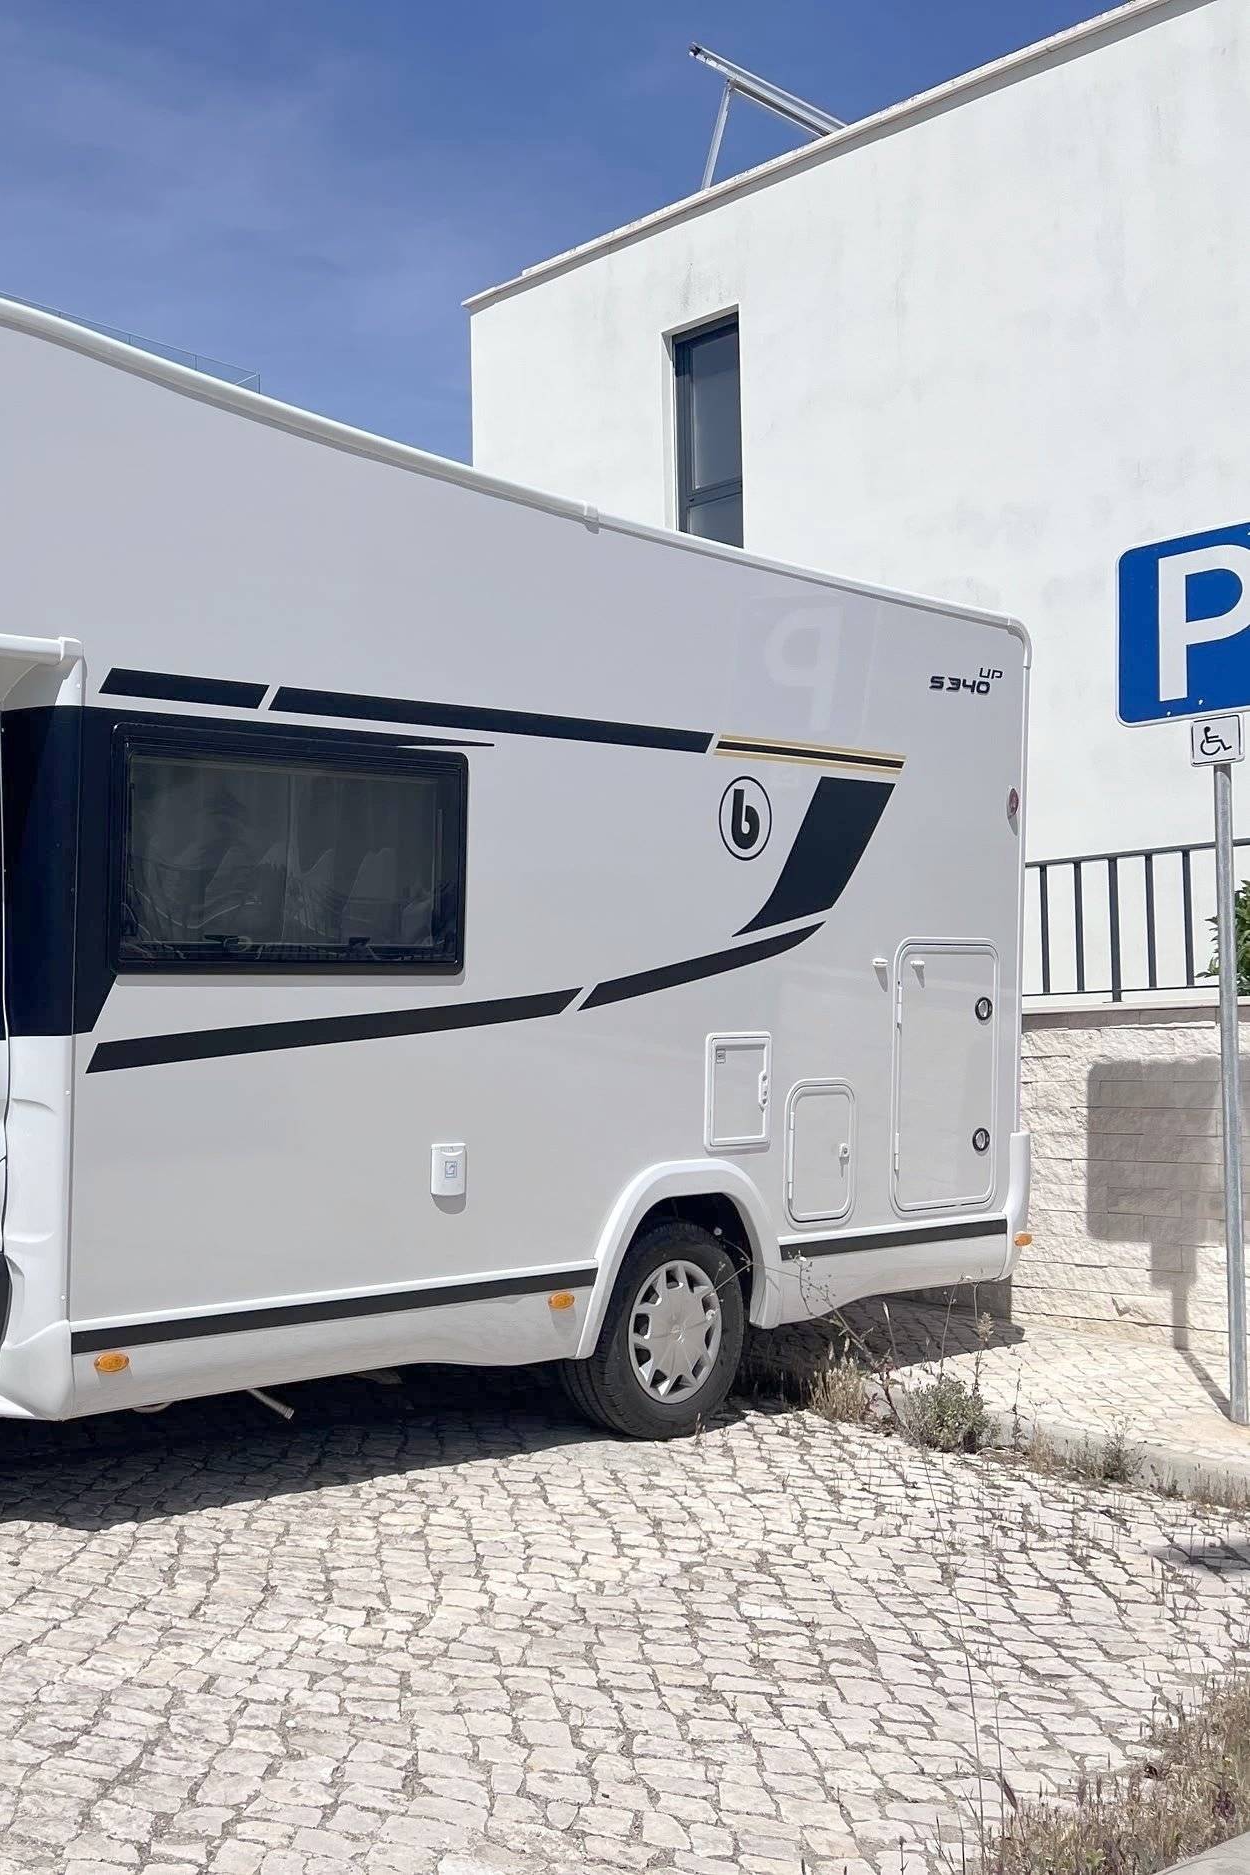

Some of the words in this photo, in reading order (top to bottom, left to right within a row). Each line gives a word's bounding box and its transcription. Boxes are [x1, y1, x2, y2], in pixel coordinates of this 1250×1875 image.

[1158, 544, 1250, 702] P
[979, 667, 1003, 680] UP
[731, 788, 760, 850] b
